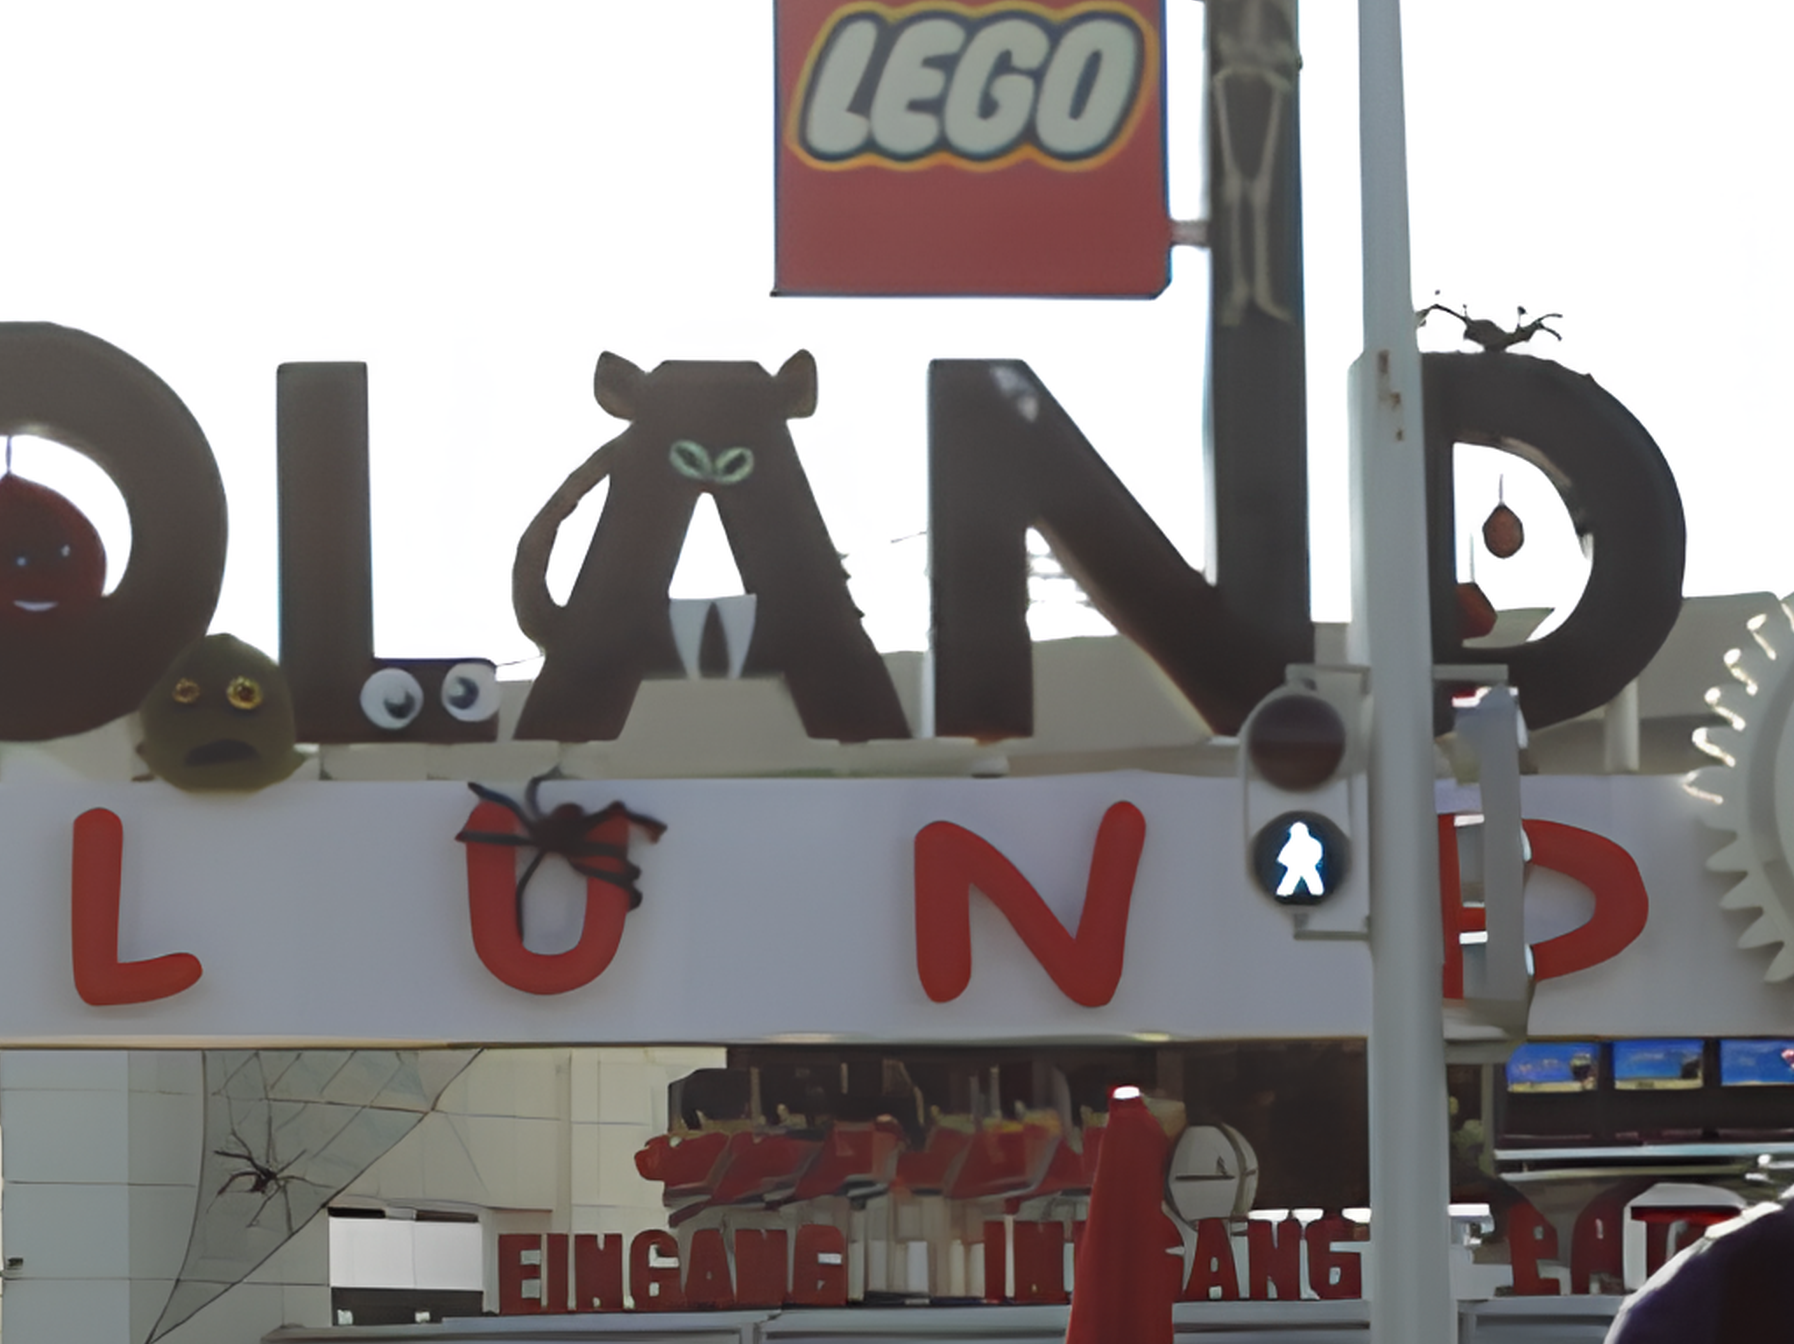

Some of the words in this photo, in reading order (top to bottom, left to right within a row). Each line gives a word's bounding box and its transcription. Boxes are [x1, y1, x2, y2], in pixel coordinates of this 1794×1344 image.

[805, 17, 1139, 158] LEGO
[498, 1222, 849, 1316] EINGANG
[983, 1216, 1364, 1304] INANG
